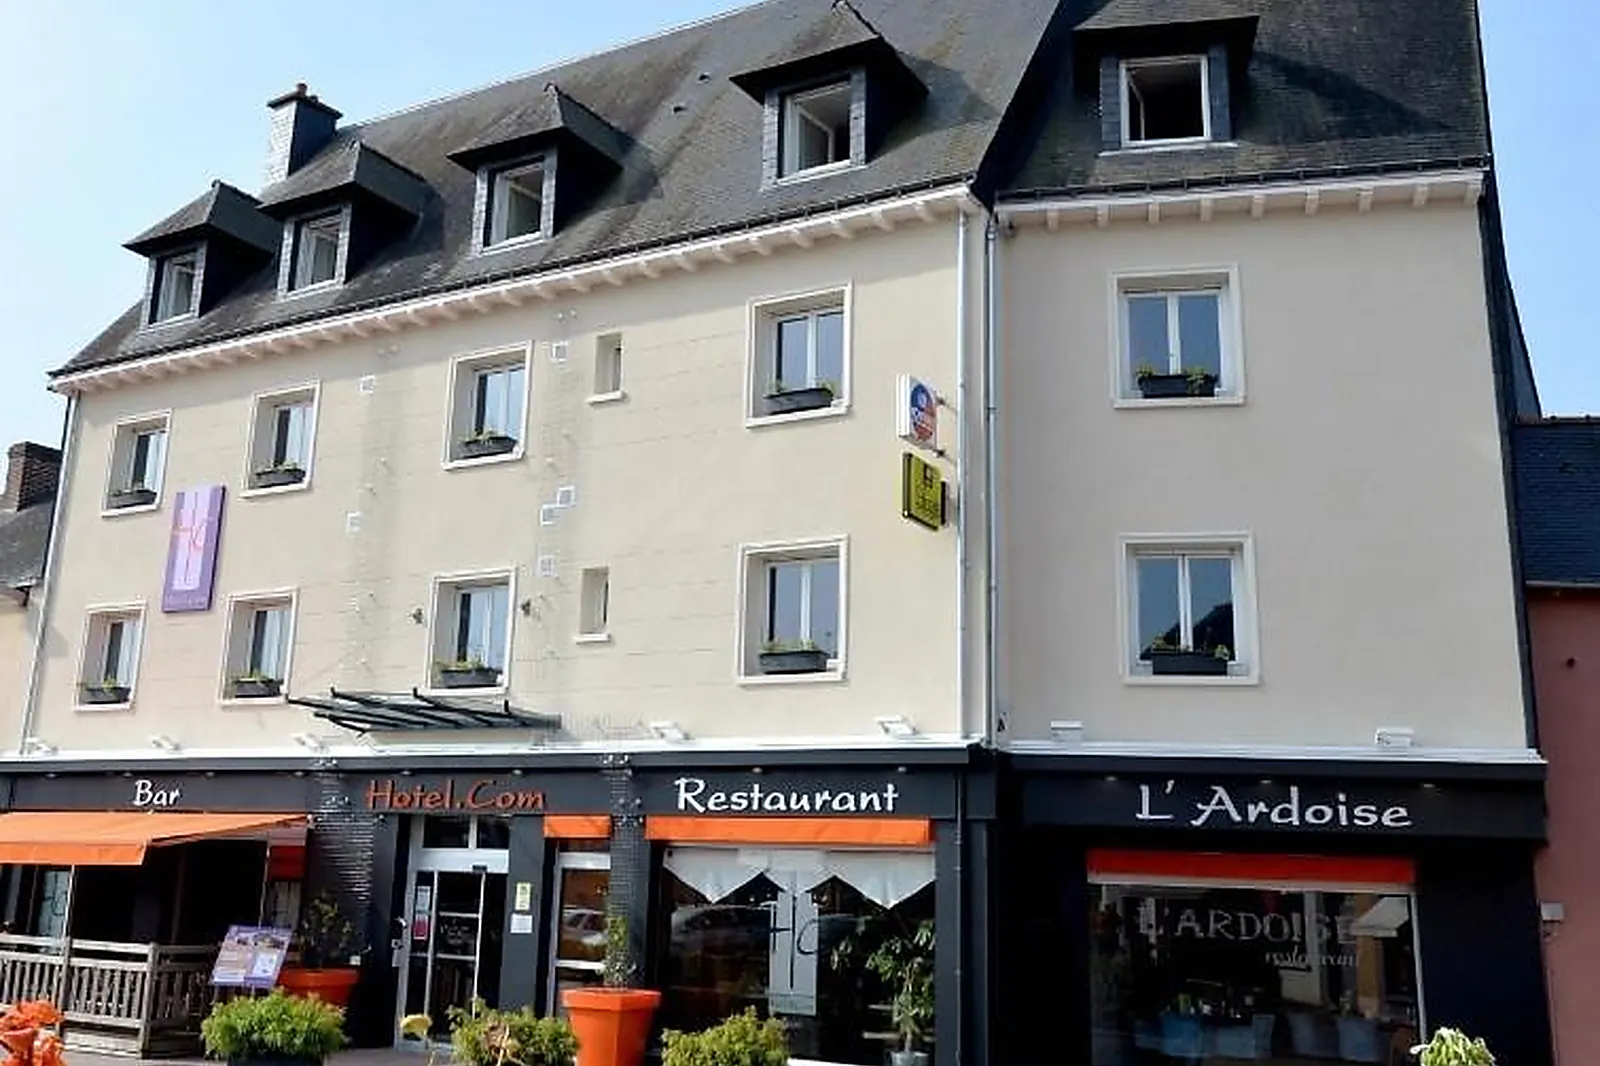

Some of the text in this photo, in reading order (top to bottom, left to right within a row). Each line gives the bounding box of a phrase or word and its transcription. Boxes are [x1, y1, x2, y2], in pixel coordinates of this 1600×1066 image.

[133, 779, 180, 806] Bar
[367, 779, 546, 810] Hotel.Com
[674, 777, 899, 813] Restaurant
